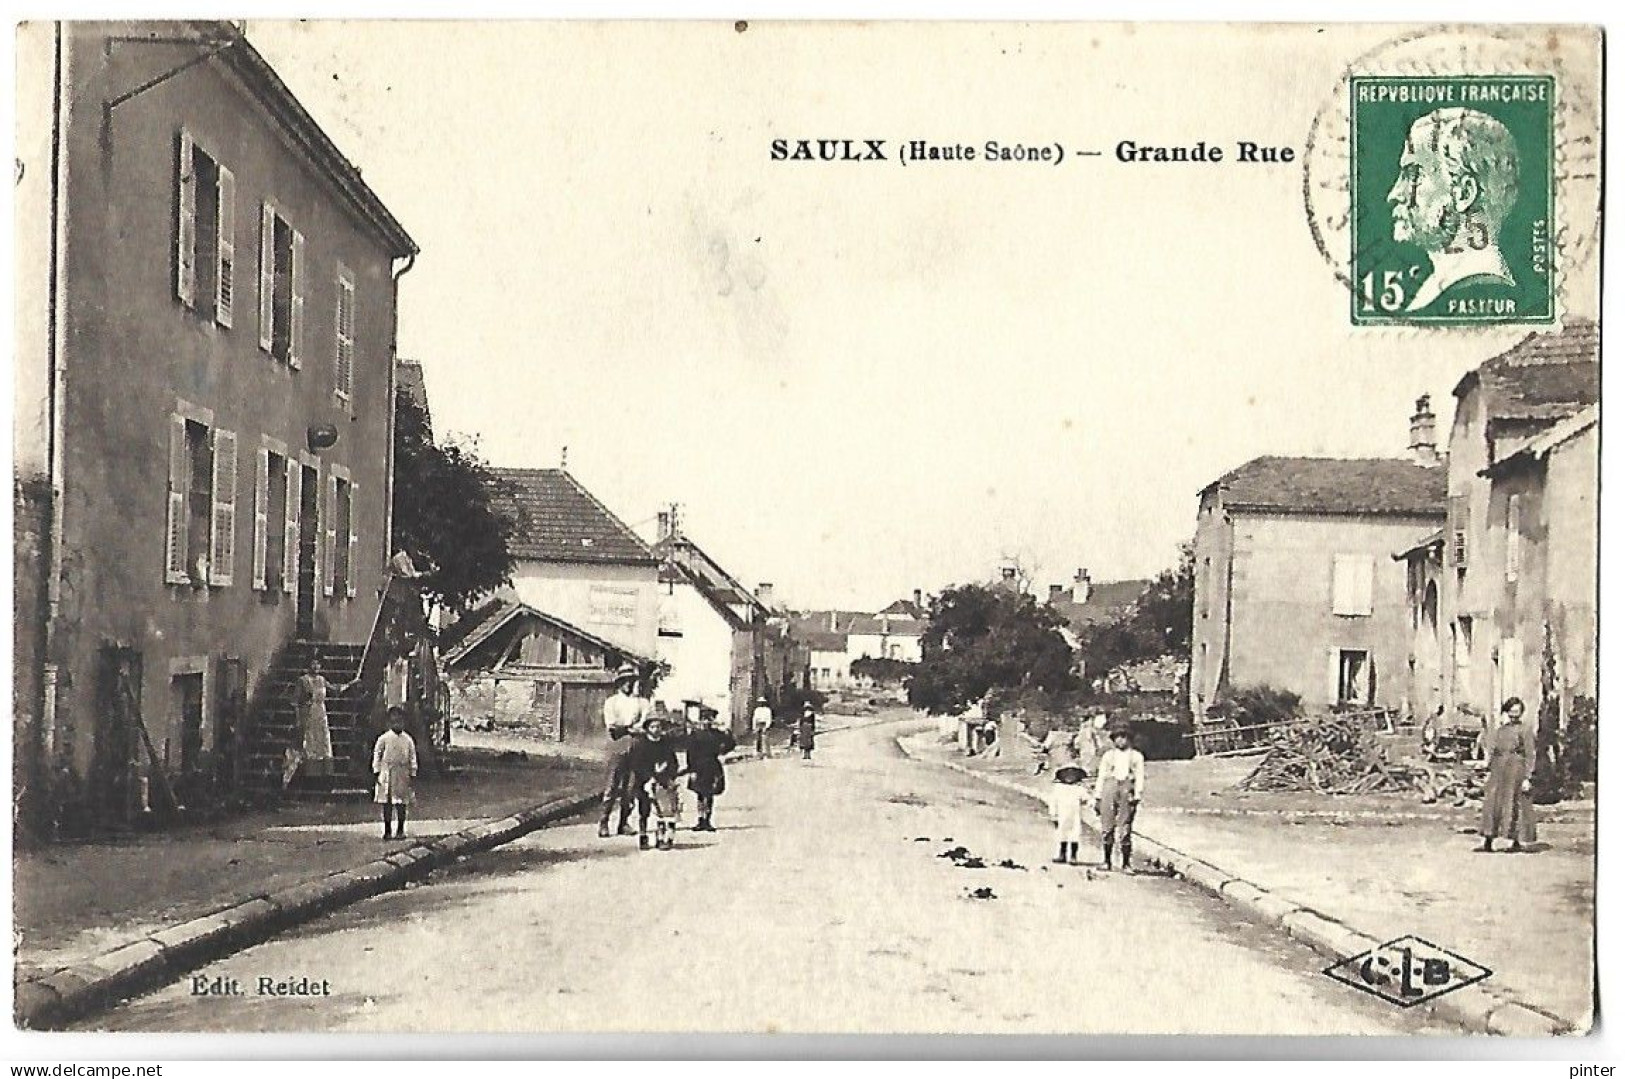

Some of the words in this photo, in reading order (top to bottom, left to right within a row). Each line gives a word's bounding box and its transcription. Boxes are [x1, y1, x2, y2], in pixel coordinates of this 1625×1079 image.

[1460, 84, 1547, 104] FRANÇAISE
[1532, 219, 1547, 273] POSTES
[1448, 298, 1516, 315] PASTEUR
